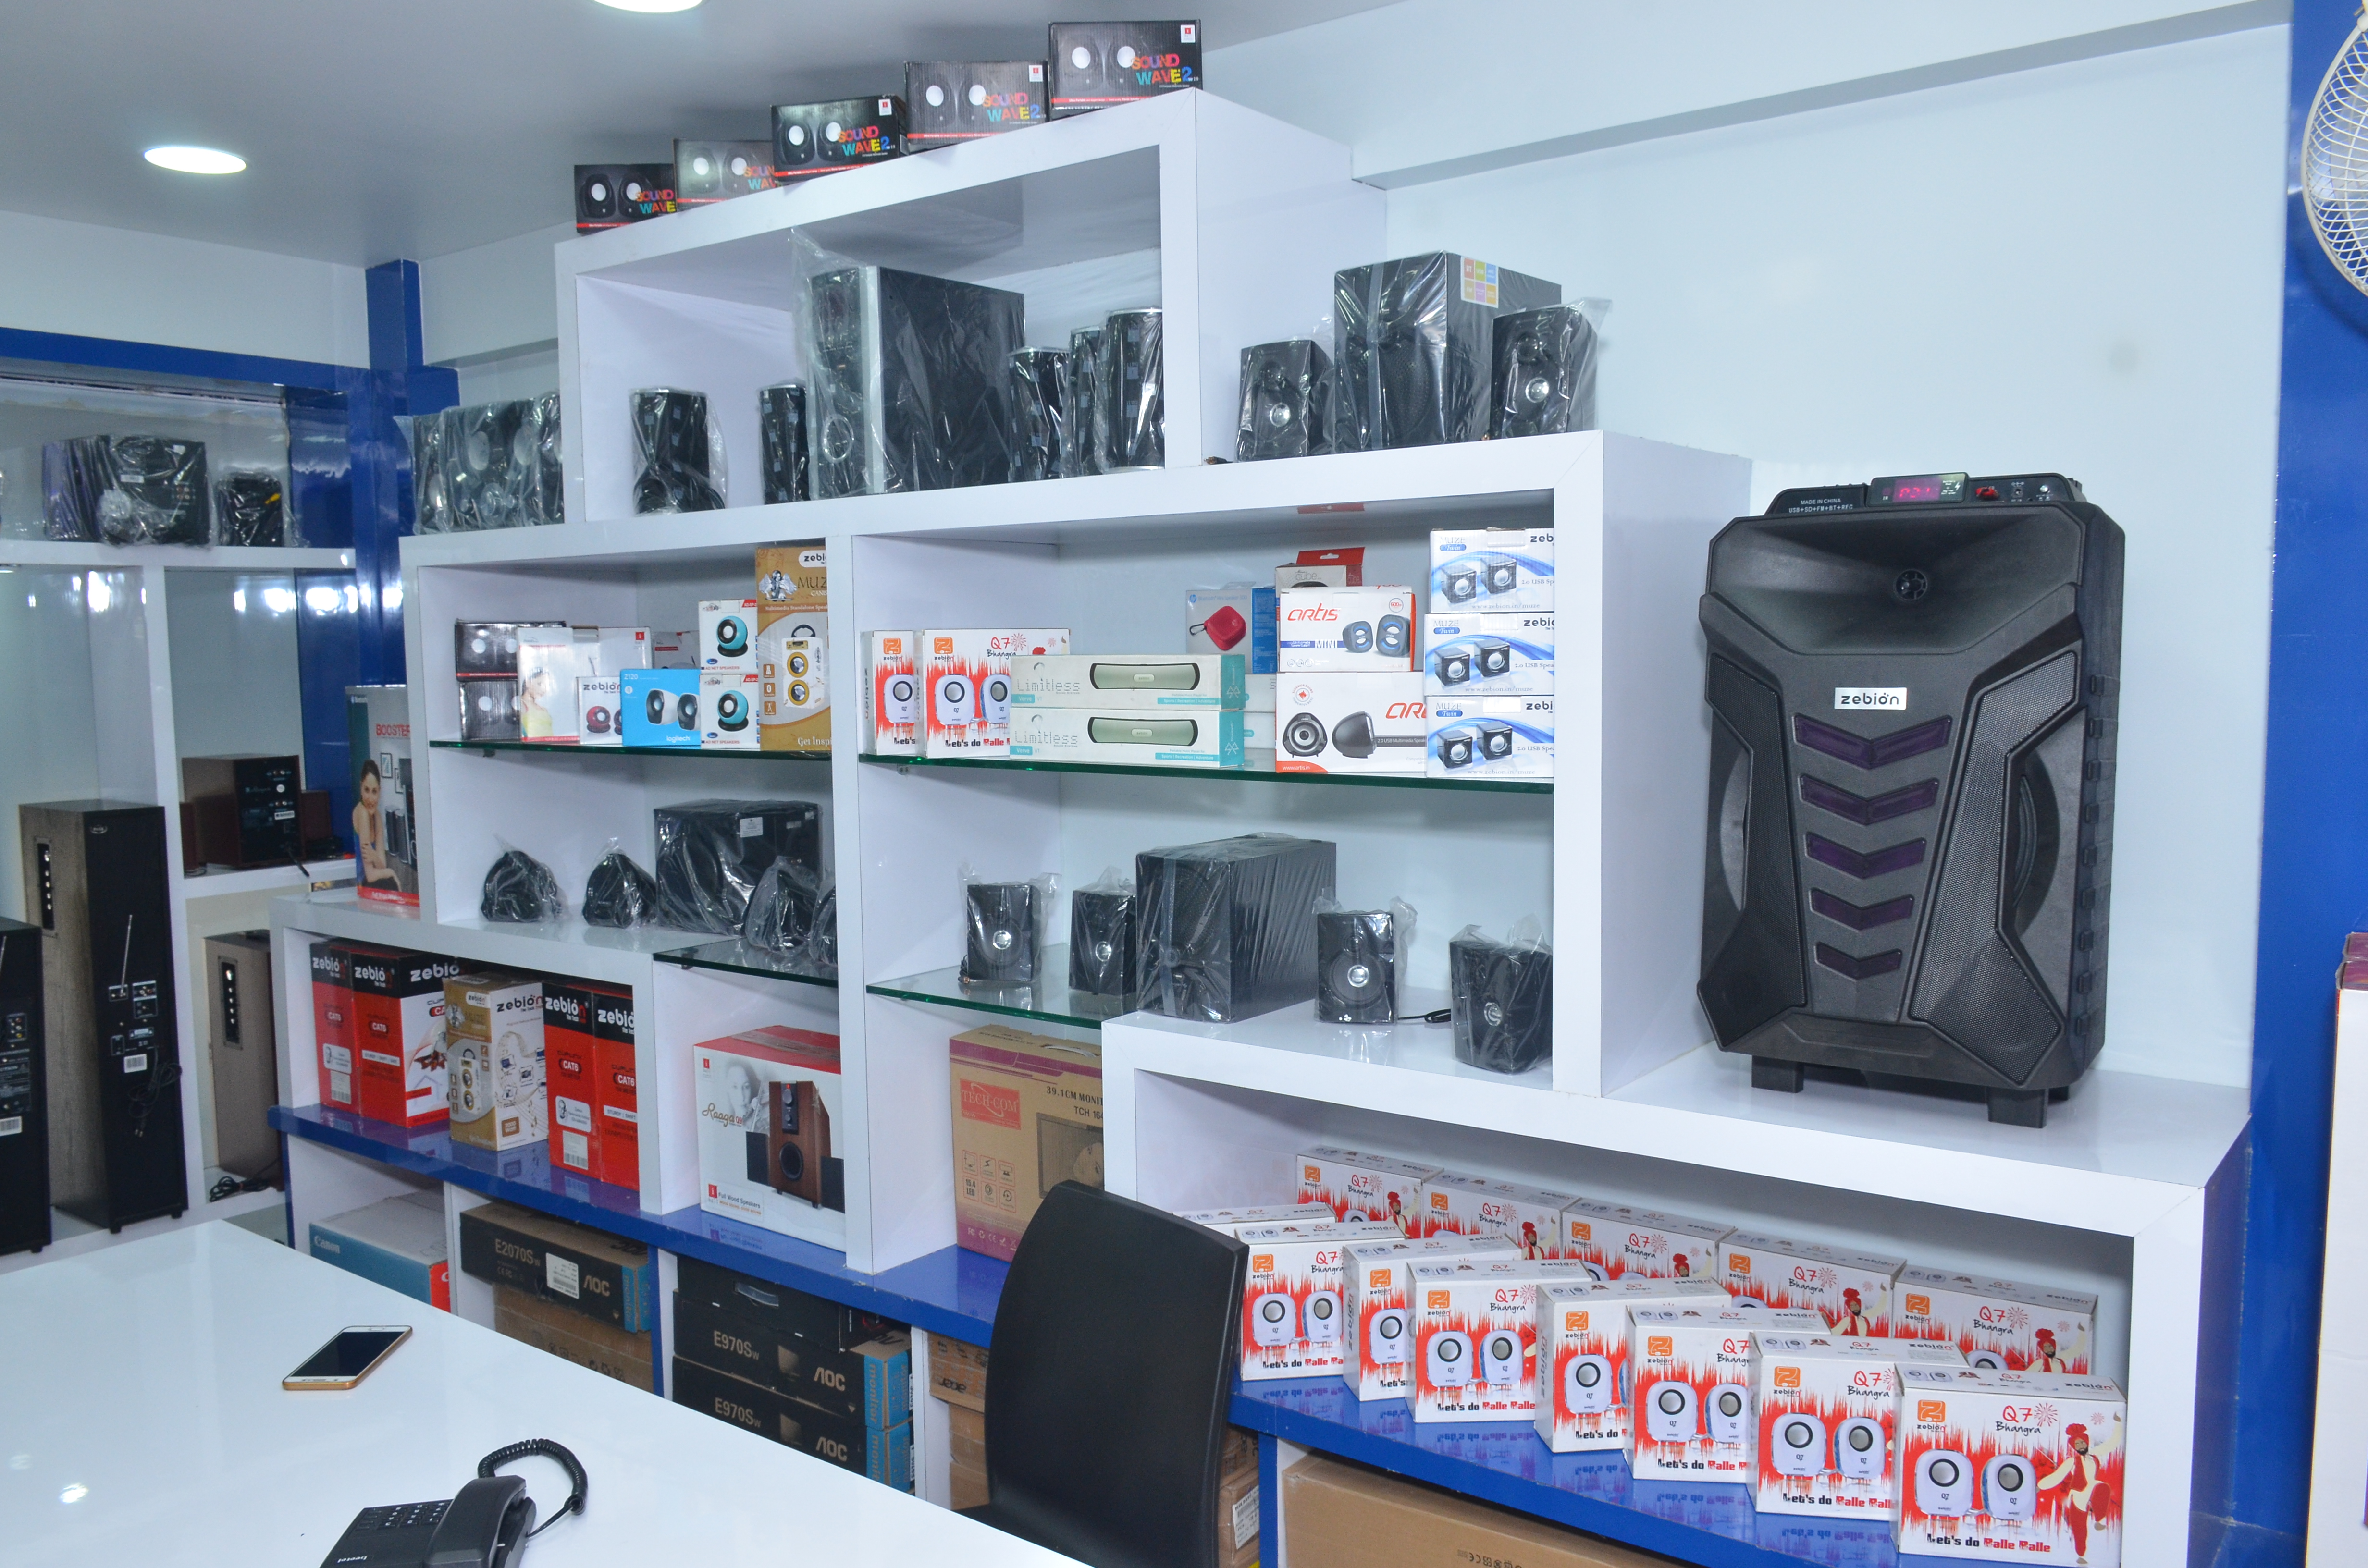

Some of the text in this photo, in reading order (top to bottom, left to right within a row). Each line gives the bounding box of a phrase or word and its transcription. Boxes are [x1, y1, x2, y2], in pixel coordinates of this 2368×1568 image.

[1132, 53, 1180, 69] SOUND
[982, 93, 1028, 107] SOUND
[838, 126, 879, 143] SOUND
[743, 166, 774, 177] SOUN
[636, 189, 674, 202] SOUND
[1530, 533, 1554, 543] zeb
[798, 577, 827, 588] MUZ
[991, 637, 1011, 649] Q7
[1315, 639, 1338, 648] MINI
[987, 649, 1017, 660] Bhangra
[1017, 679, 1080, 692] Limitless
[1526, 701, 1554, 710] zebi
[798, 737, 811, 747] Get
[1015, 730, 1078, 744] Limitless
[410, 964, 460, 982] zebio
[598, 1008, 635, 1027] zebio
[563, 1060, 579, 1071] CAT6
[618, 1075, 635, 1086] CAT6
[962, 1090, 1018, 1113] TECH-COM
[1046, 1085, 1103, 1106] 39.1CM MONIT
[702, 1102, 735, 1127] Raaga
[1074, 1106, 1090, 1117] TCH
[965, 1178, 975, 1188] 15.4
[1351, 1174, 1369, 1188] Q7
[1347, 1184, 1374, 1198] Bhangra
[727, 1194, 739, 1202] Wood
[740, 1198, 760, 1208] Speakers
[1482, 1203, 1501, 1217] Q7
[1479, 1213, 1507, 1227] Bhangra
[314, 1235, 340, 1254] Canon
[1629, 1233, 1650, 1248] Q7
[1316, 1251, 1338, 1265] Q7
[1624, 1244, 1656, 1260] Bhangra
[1311, 1265, 1343, 1274] Bhangra
[1794, 1266, 1817, 1282] Q7
[583, 1275, 610, 1297] AOC
[1788, 1278, 1824, 1294] Bhangra
[1495, 1288, 1519, 1303] Q7
[1490, 1303, 1526, 1313] Bhangra
[1979, 1306, 2007, 1323] Q7
[1973, 1319, 2013, 1336] Bhangra
[1723, 1339, 1749, 1354] Q7
[1291, 1360, 1302, 1368] do
[814, 1366, 845, 1392] AOC
[938, 1377, 967, 1393] acer
[1853, 1371, 1882, 1387] Q7
[1847, 1385, 1890, 1400] Bhangra
[1468, 1402, 1479, 1411] do
[2002, 1405, 2033, 1422] Q7
[1607, 1429, 1618, 1437] do
[1995, 1421, 2041, 1436] Bhangra
[816, 1436, 848, 1462] AOC
[1691, 1459, 1704, 1469] do
[1818, 1495, 1832, 1505] do
[1965, 1536, 1980, 1547] do
